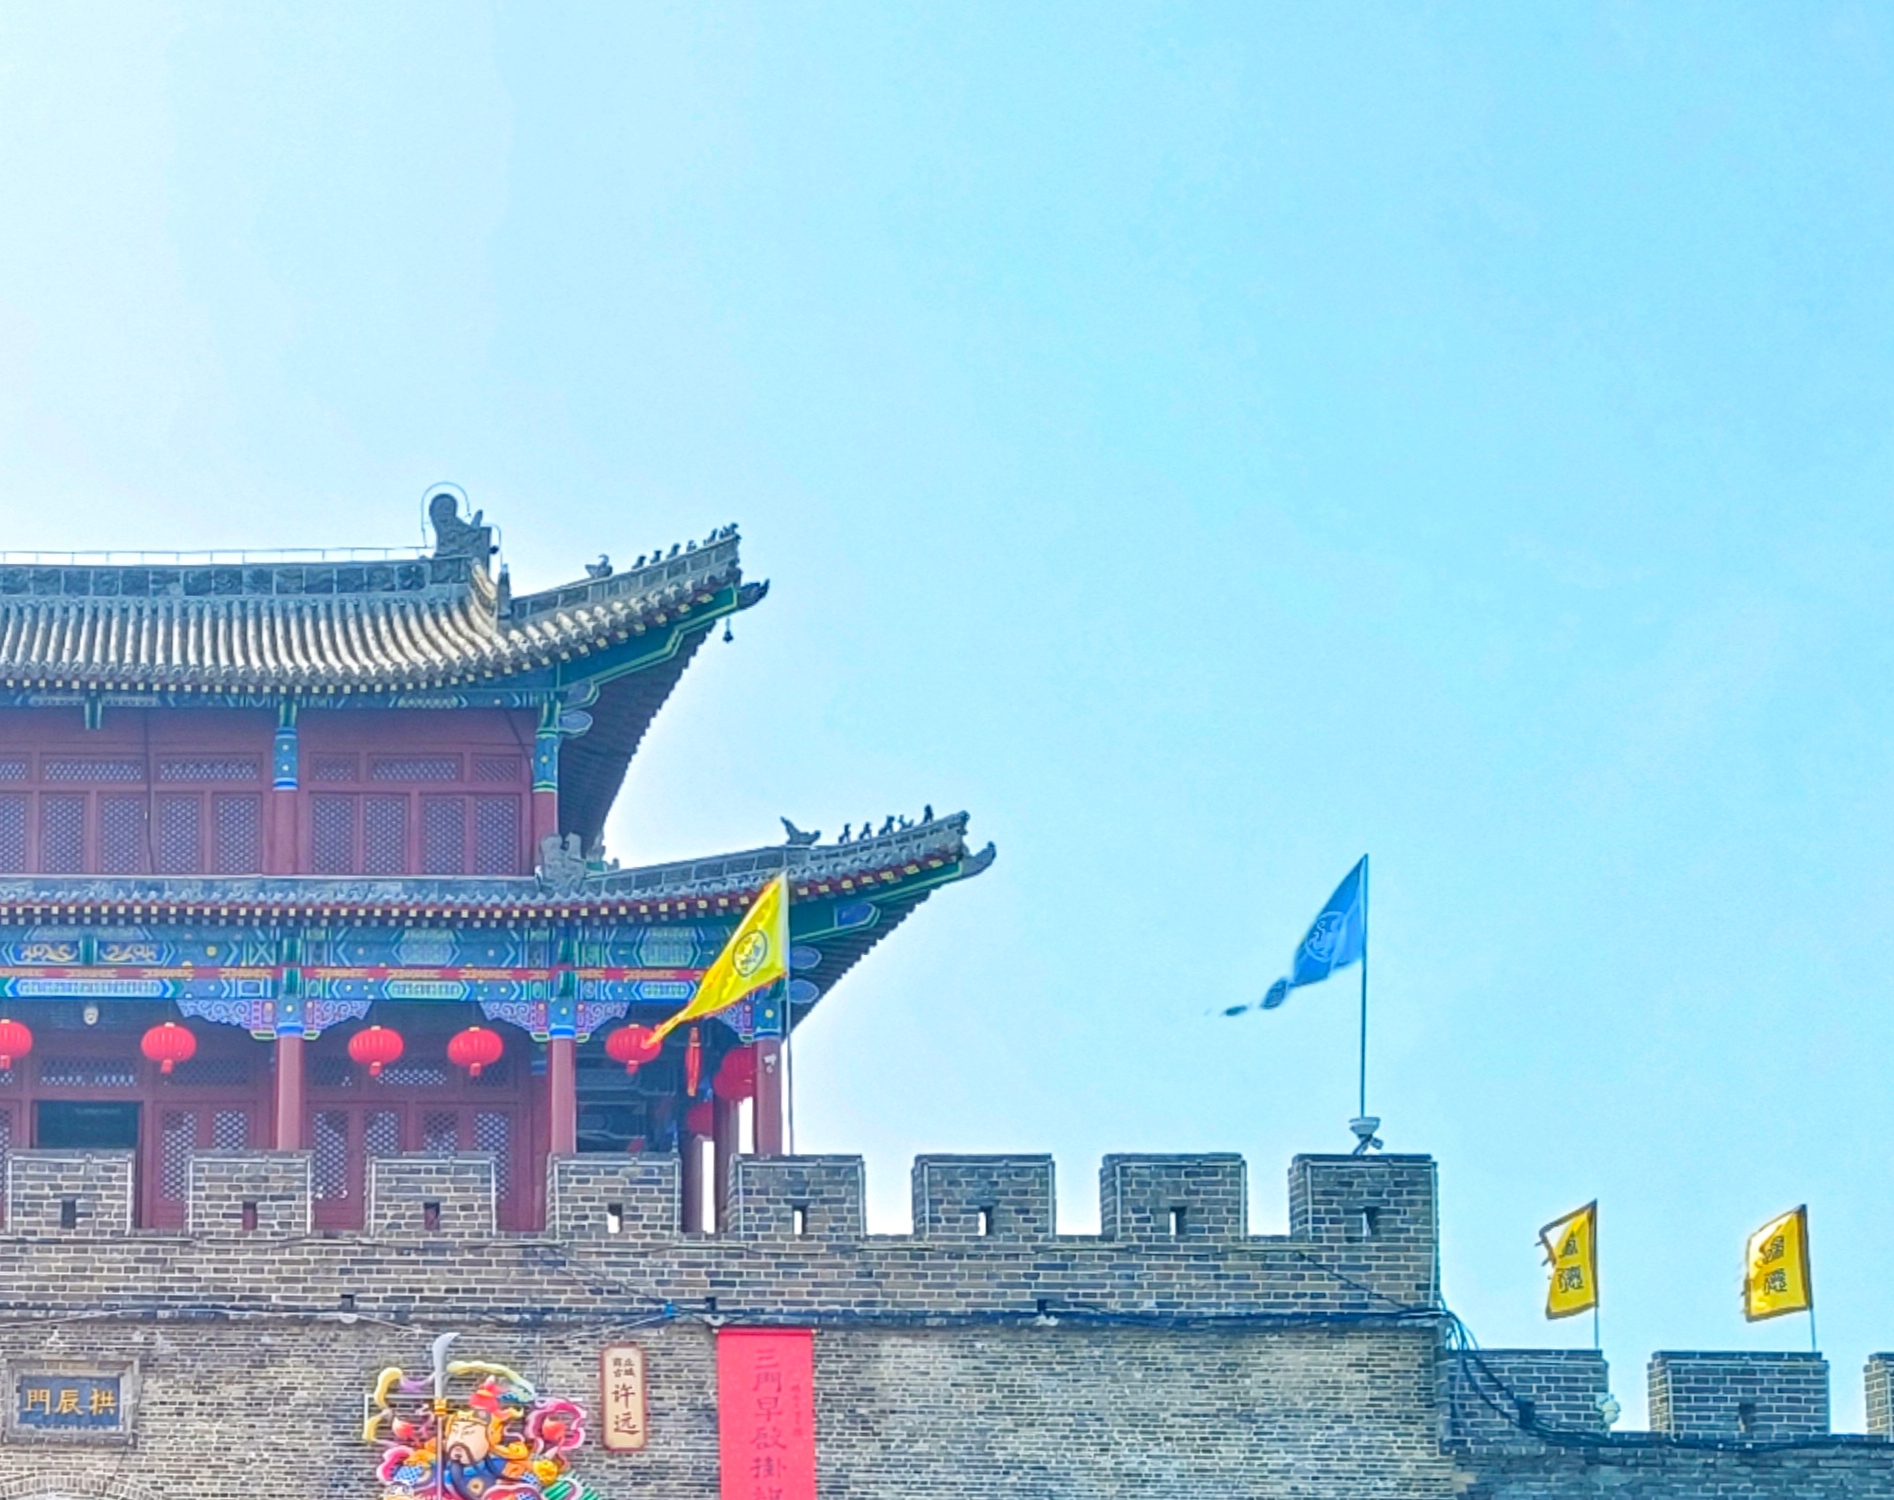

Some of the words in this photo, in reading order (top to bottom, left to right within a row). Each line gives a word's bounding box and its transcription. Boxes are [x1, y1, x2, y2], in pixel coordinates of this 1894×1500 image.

[23, 1387, 117, 1416] 拱辰門
[611, 1382, 640, 1436] 许远
